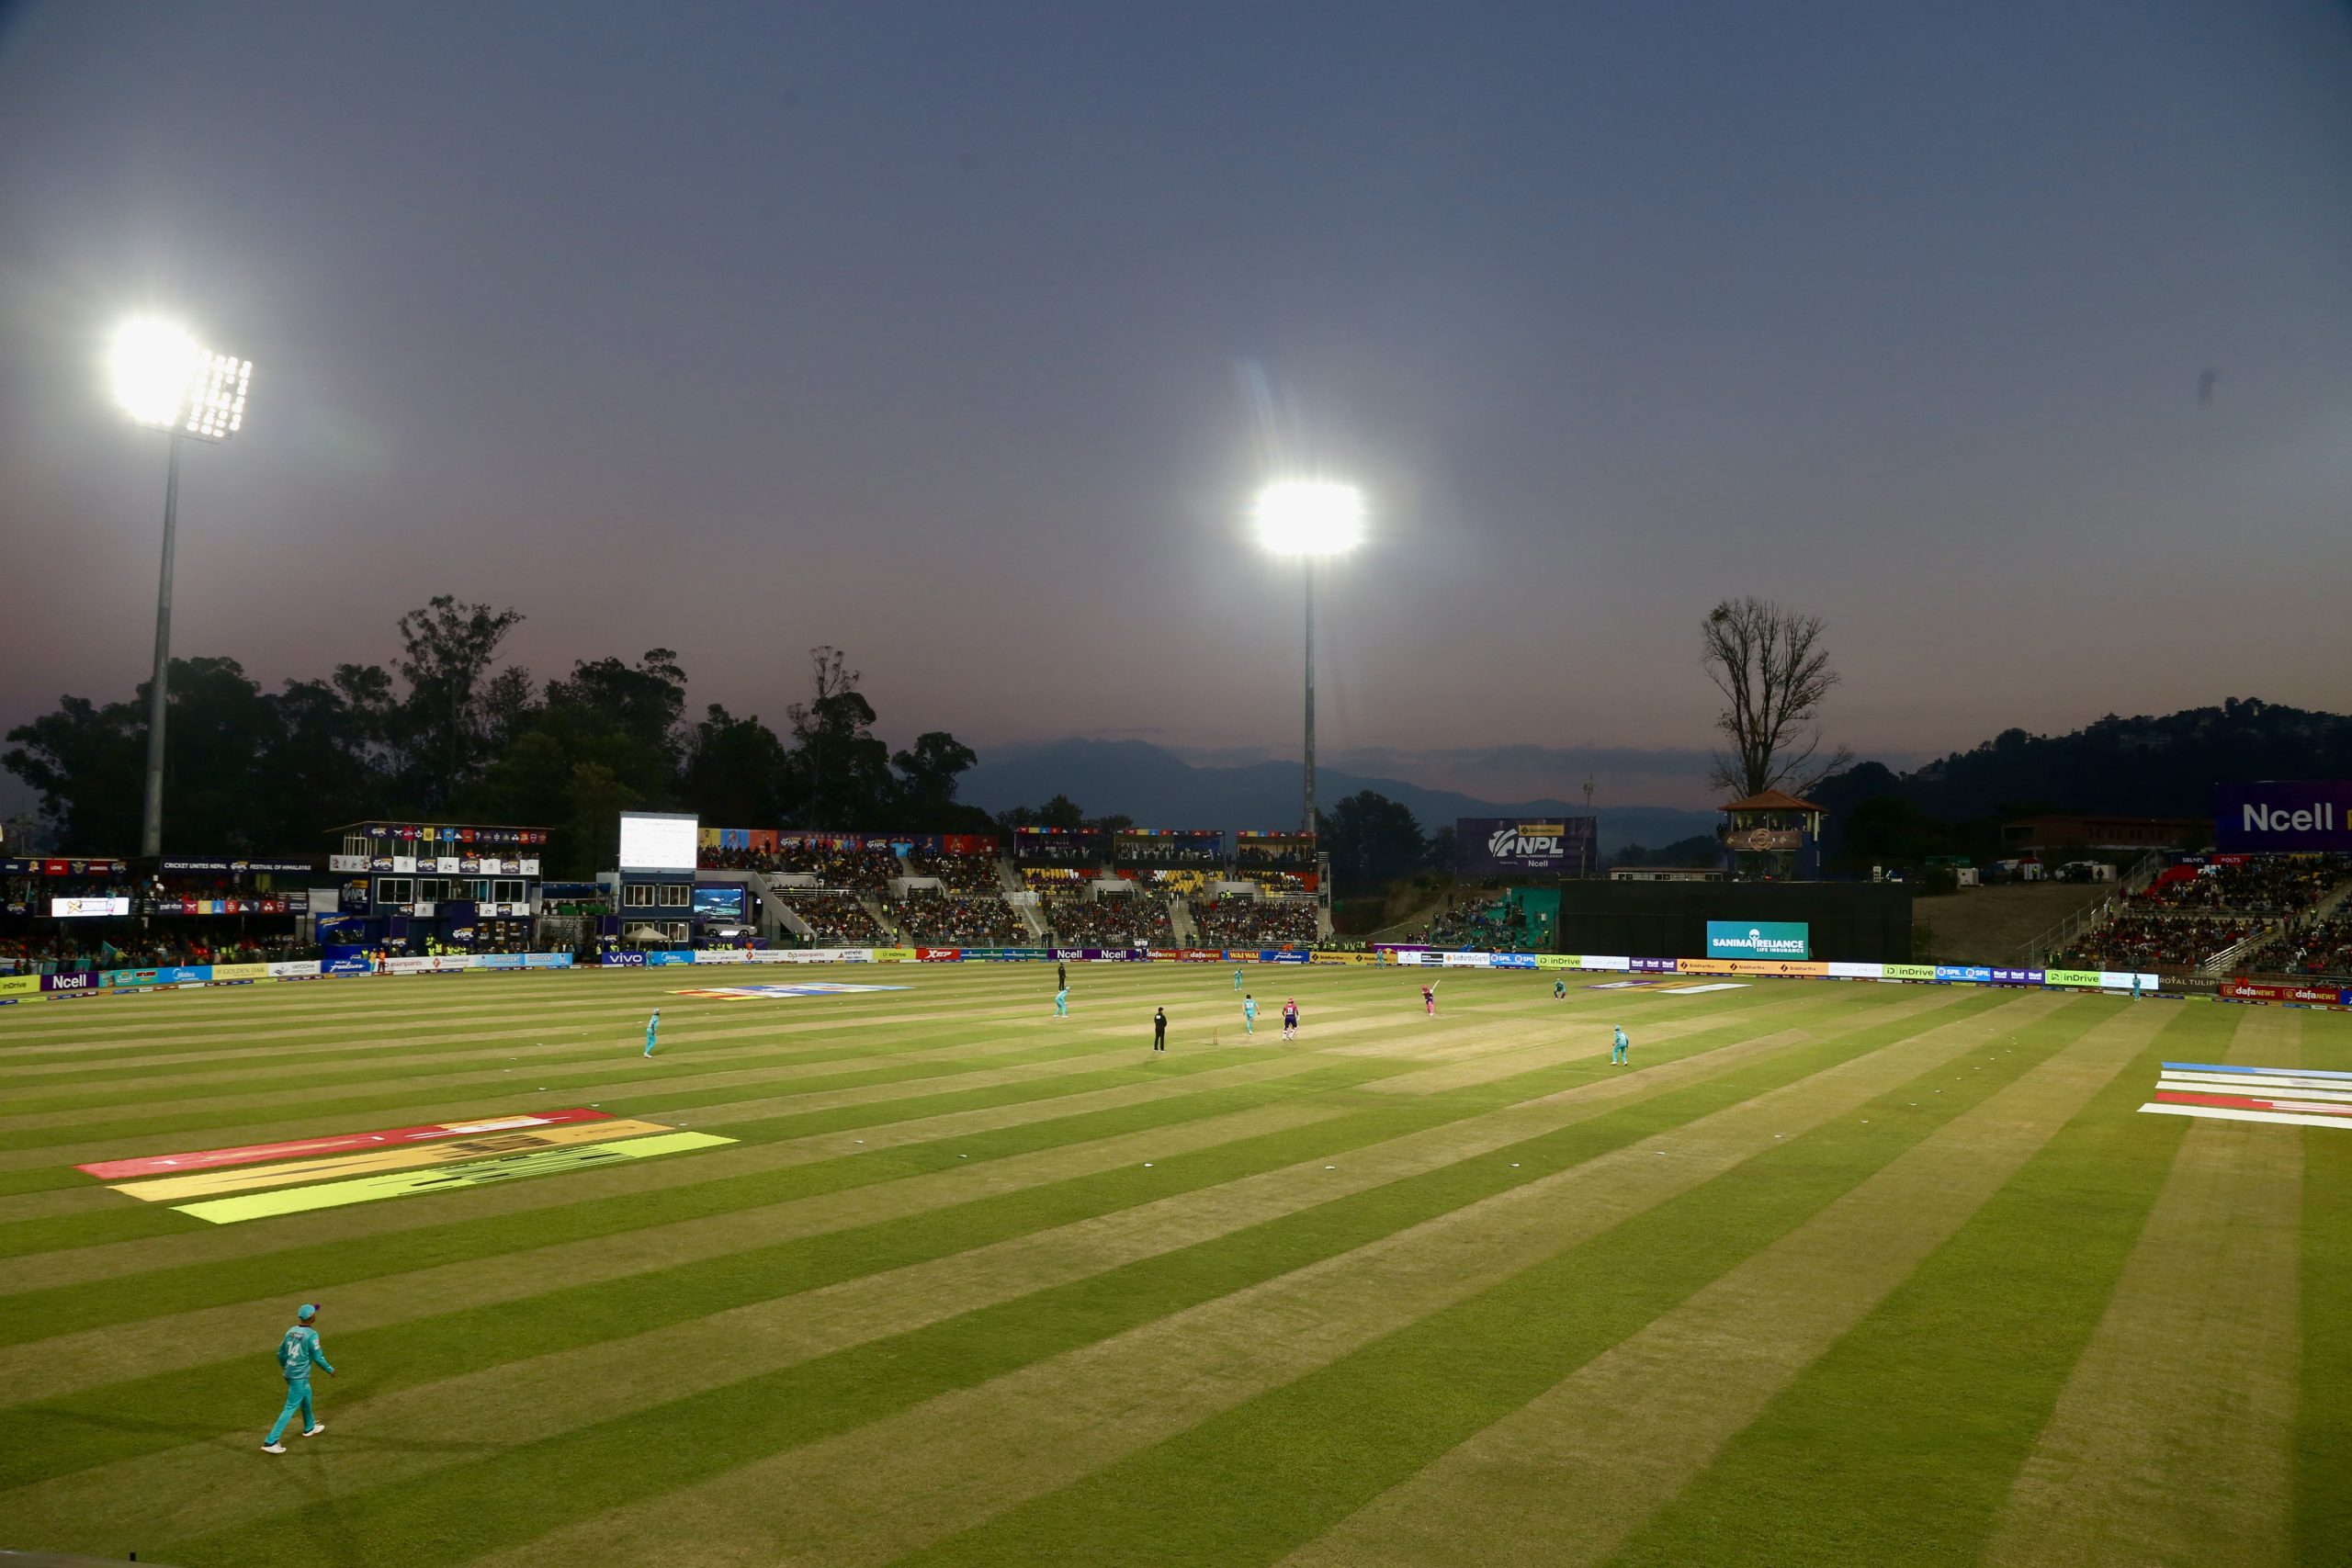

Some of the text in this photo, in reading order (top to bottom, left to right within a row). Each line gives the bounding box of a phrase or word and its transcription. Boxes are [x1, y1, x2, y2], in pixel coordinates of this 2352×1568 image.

[2243, 803, 2333, 831] Ncell
[1516, 837, 1564, 854] NPL
[1528, 859, 1548, 867] Ncell
[1713, 938, 1804, 949] SANIMA RELIANCE
[1057, 950, 1082, 958] Ncell
[1102, 950, 1126, 958] Ncell
[1550, 957, 1580, 965] inDrive
[1899, 968, 1934, 976] inDrive
[52, 974, 86, 989] Ncell
[2064, 974, 2099, 983] inDrive
[2160, 976, 2187, 986] ROYAL
[2189, 978, 2216, 987] TULIP
[2235, 987, 2276, 997] dafaNEWS
[2295, 989, 2336, 1000] dafaNEWS
[287, 1340, 301, 1359] 14
